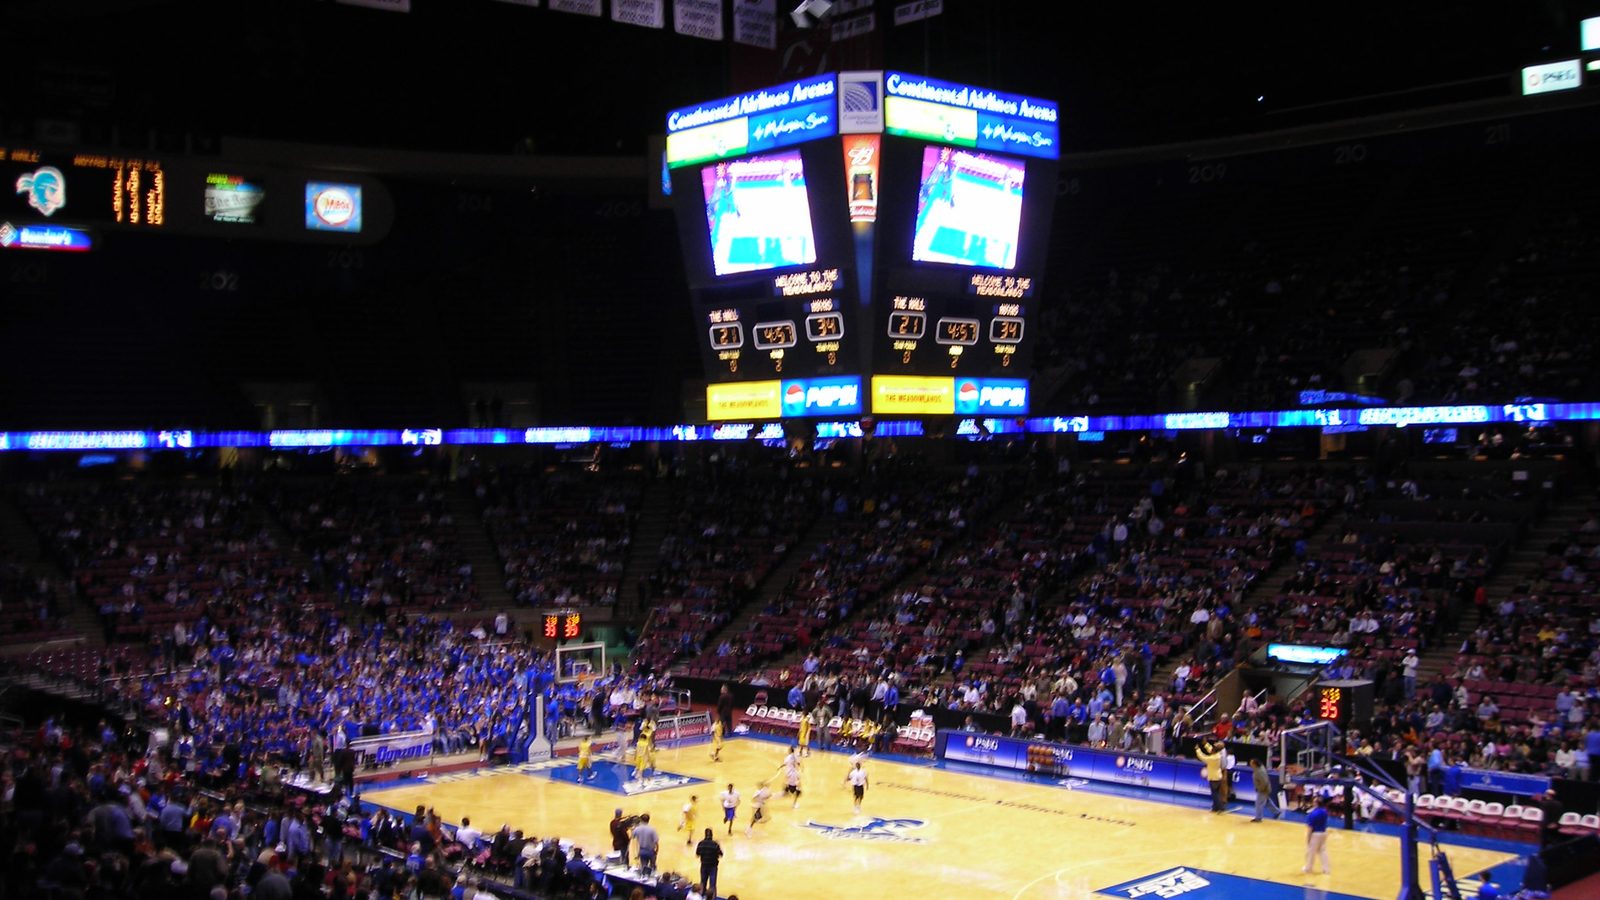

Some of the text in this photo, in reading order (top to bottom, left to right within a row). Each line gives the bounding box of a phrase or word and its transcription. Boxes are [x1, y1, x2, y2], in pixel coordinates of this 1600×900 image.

[668, 80, 834, 131] Continental Airlines Arena
[887, 74, 1058, 122] Continental Airlines Arena
[1333, 144, 1367, 164] 210
[1188, 163, 1227, 184] 209
[775, 268, 838, 288] WELCOME TO THE
[971, 274, 1031, 290] WELCOME TO THE
[782, 281, 833, 297] MEADOWLANDS
[976, 284, 1024, 298] MEADOWLANDS
[893, 296, 907, 310] THE
[709, 309, 722, 323] THE
[899, 315, 918, 335] 21
[719, 327, 738, 346] 21
[817, 317, 837, 337] 34
[947, 322, 977, 342] 4:57
[1000, 320, 1018, 340] 34
[806, 384, 859, 408] PEPSI
[979, 386, 1026, 407] PEPSI
[1320, 697, 1338, 719] 35
[354, 749, 377, 767] The
[1126, 756, 1153, 772] PSEG
